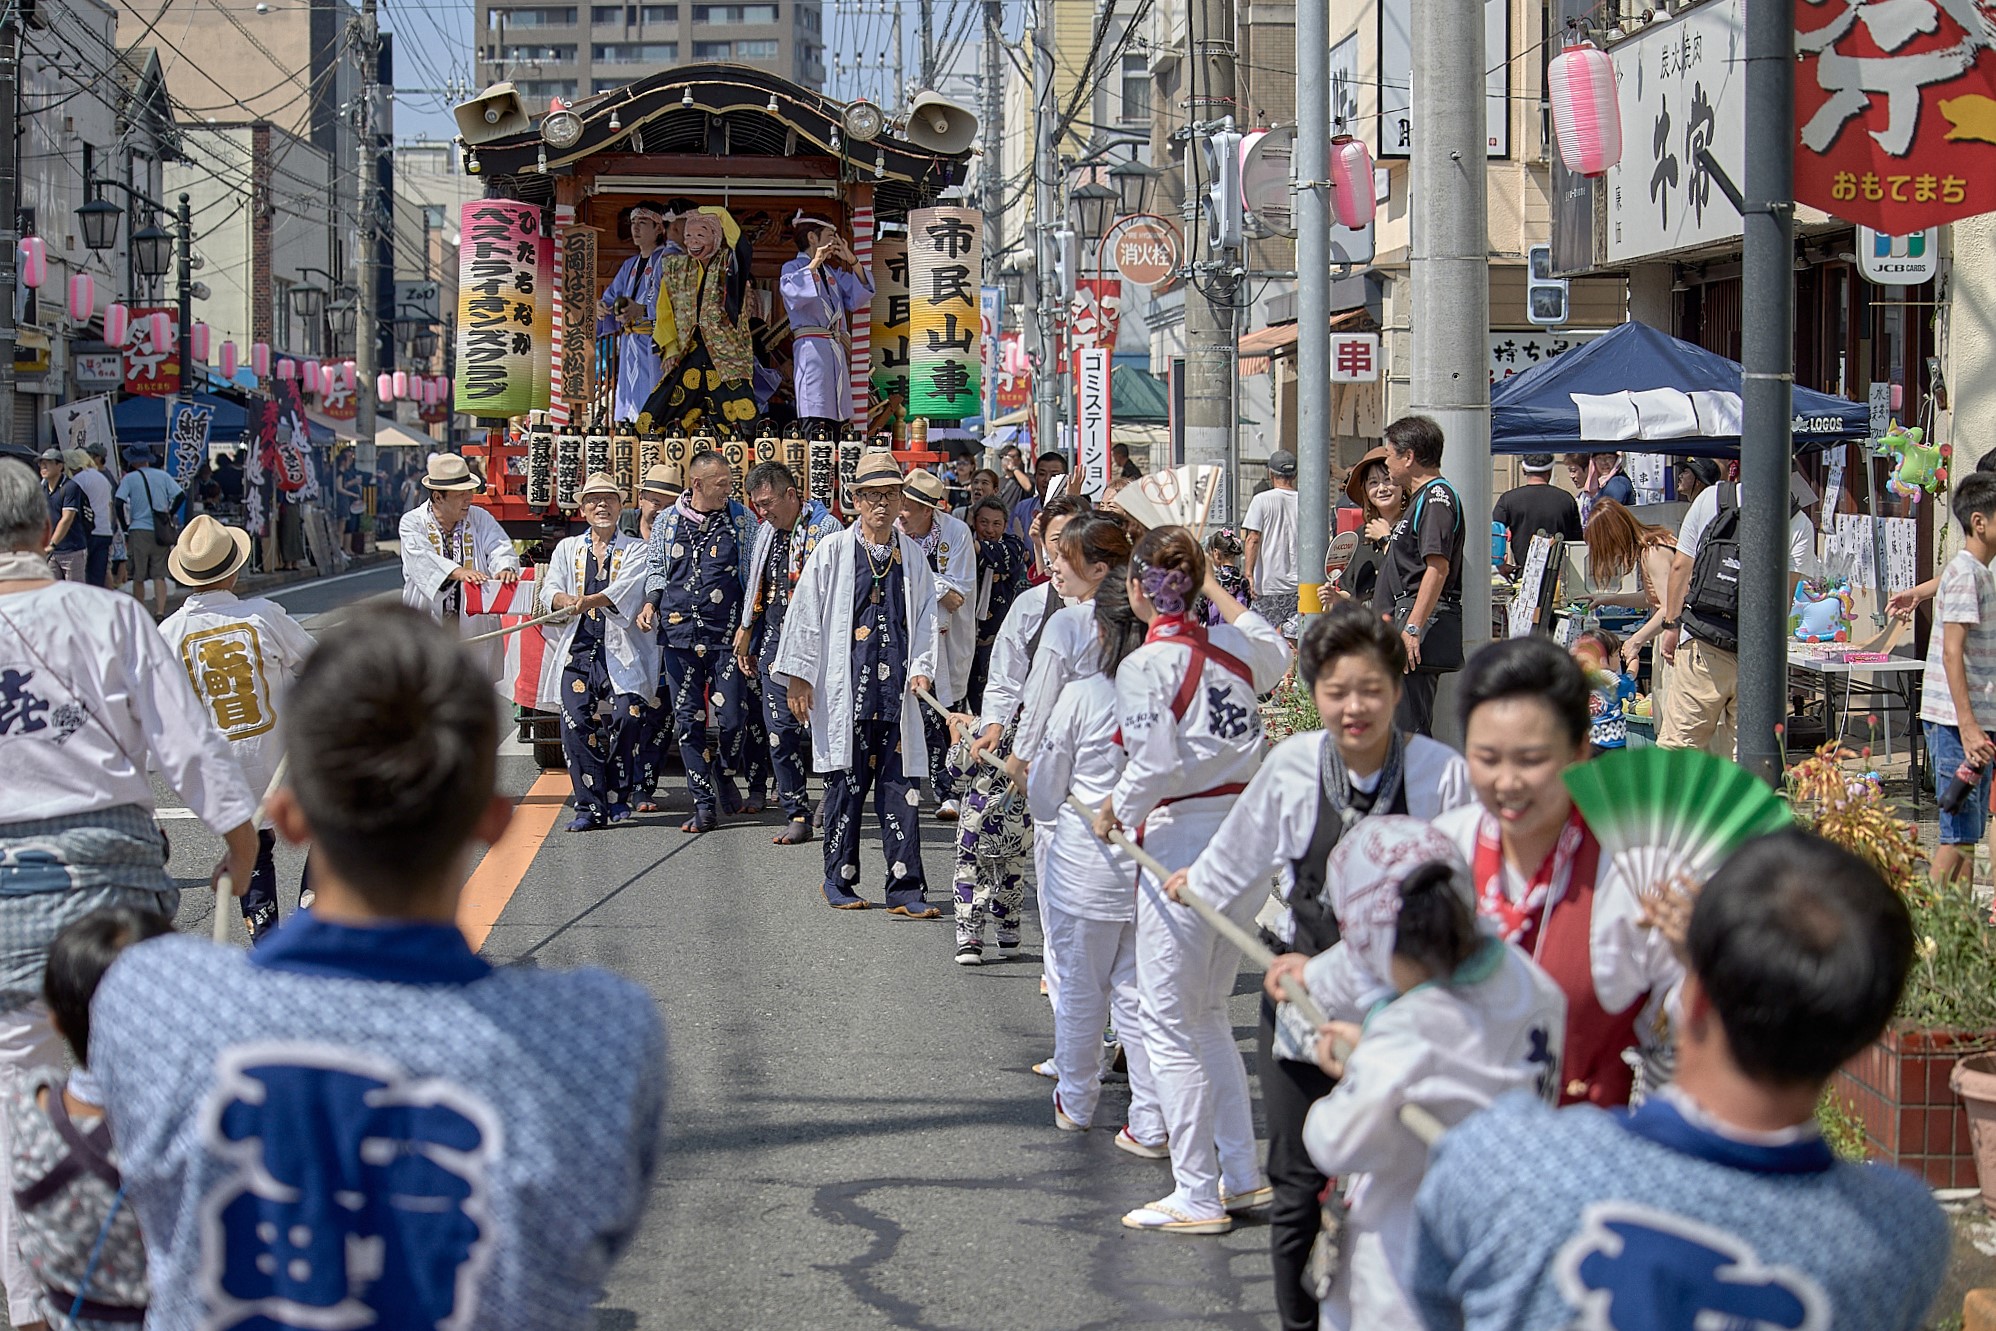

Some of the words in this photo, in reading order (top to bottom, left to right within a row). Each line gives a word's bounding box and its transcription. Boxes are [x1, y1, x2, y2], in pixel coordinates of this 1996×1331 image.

[1660, 31, 1703, 81] 炭火焼肉
[1831, 171, 1967, 203] おもてまち
[1121, 243, 1170, 266] 消火栓
[1873, 264, 1905, 273] JCB
[1906, 264, 1926, 273] CARDS
[511, 210, 538, 356] ひたちなか
[464, 207, 518, 400] ベストライオンズクラブ
[562, 232, 588, 400] 石岡ばやし若松連
[924, 217, 976, 403] 市民山車
[1338, 340, 1371, 377] 串
[1493, 339, 1589, 363] 持ち帰
[1085, 353, 1103, 496] ゴミステーション
[1810, 416, 1843, 431] LOGOS
[877, 614, 891, 643] 七町目
[767, 693, 779, 719] 七町目
[885, 813, 905, 841] 七町目
